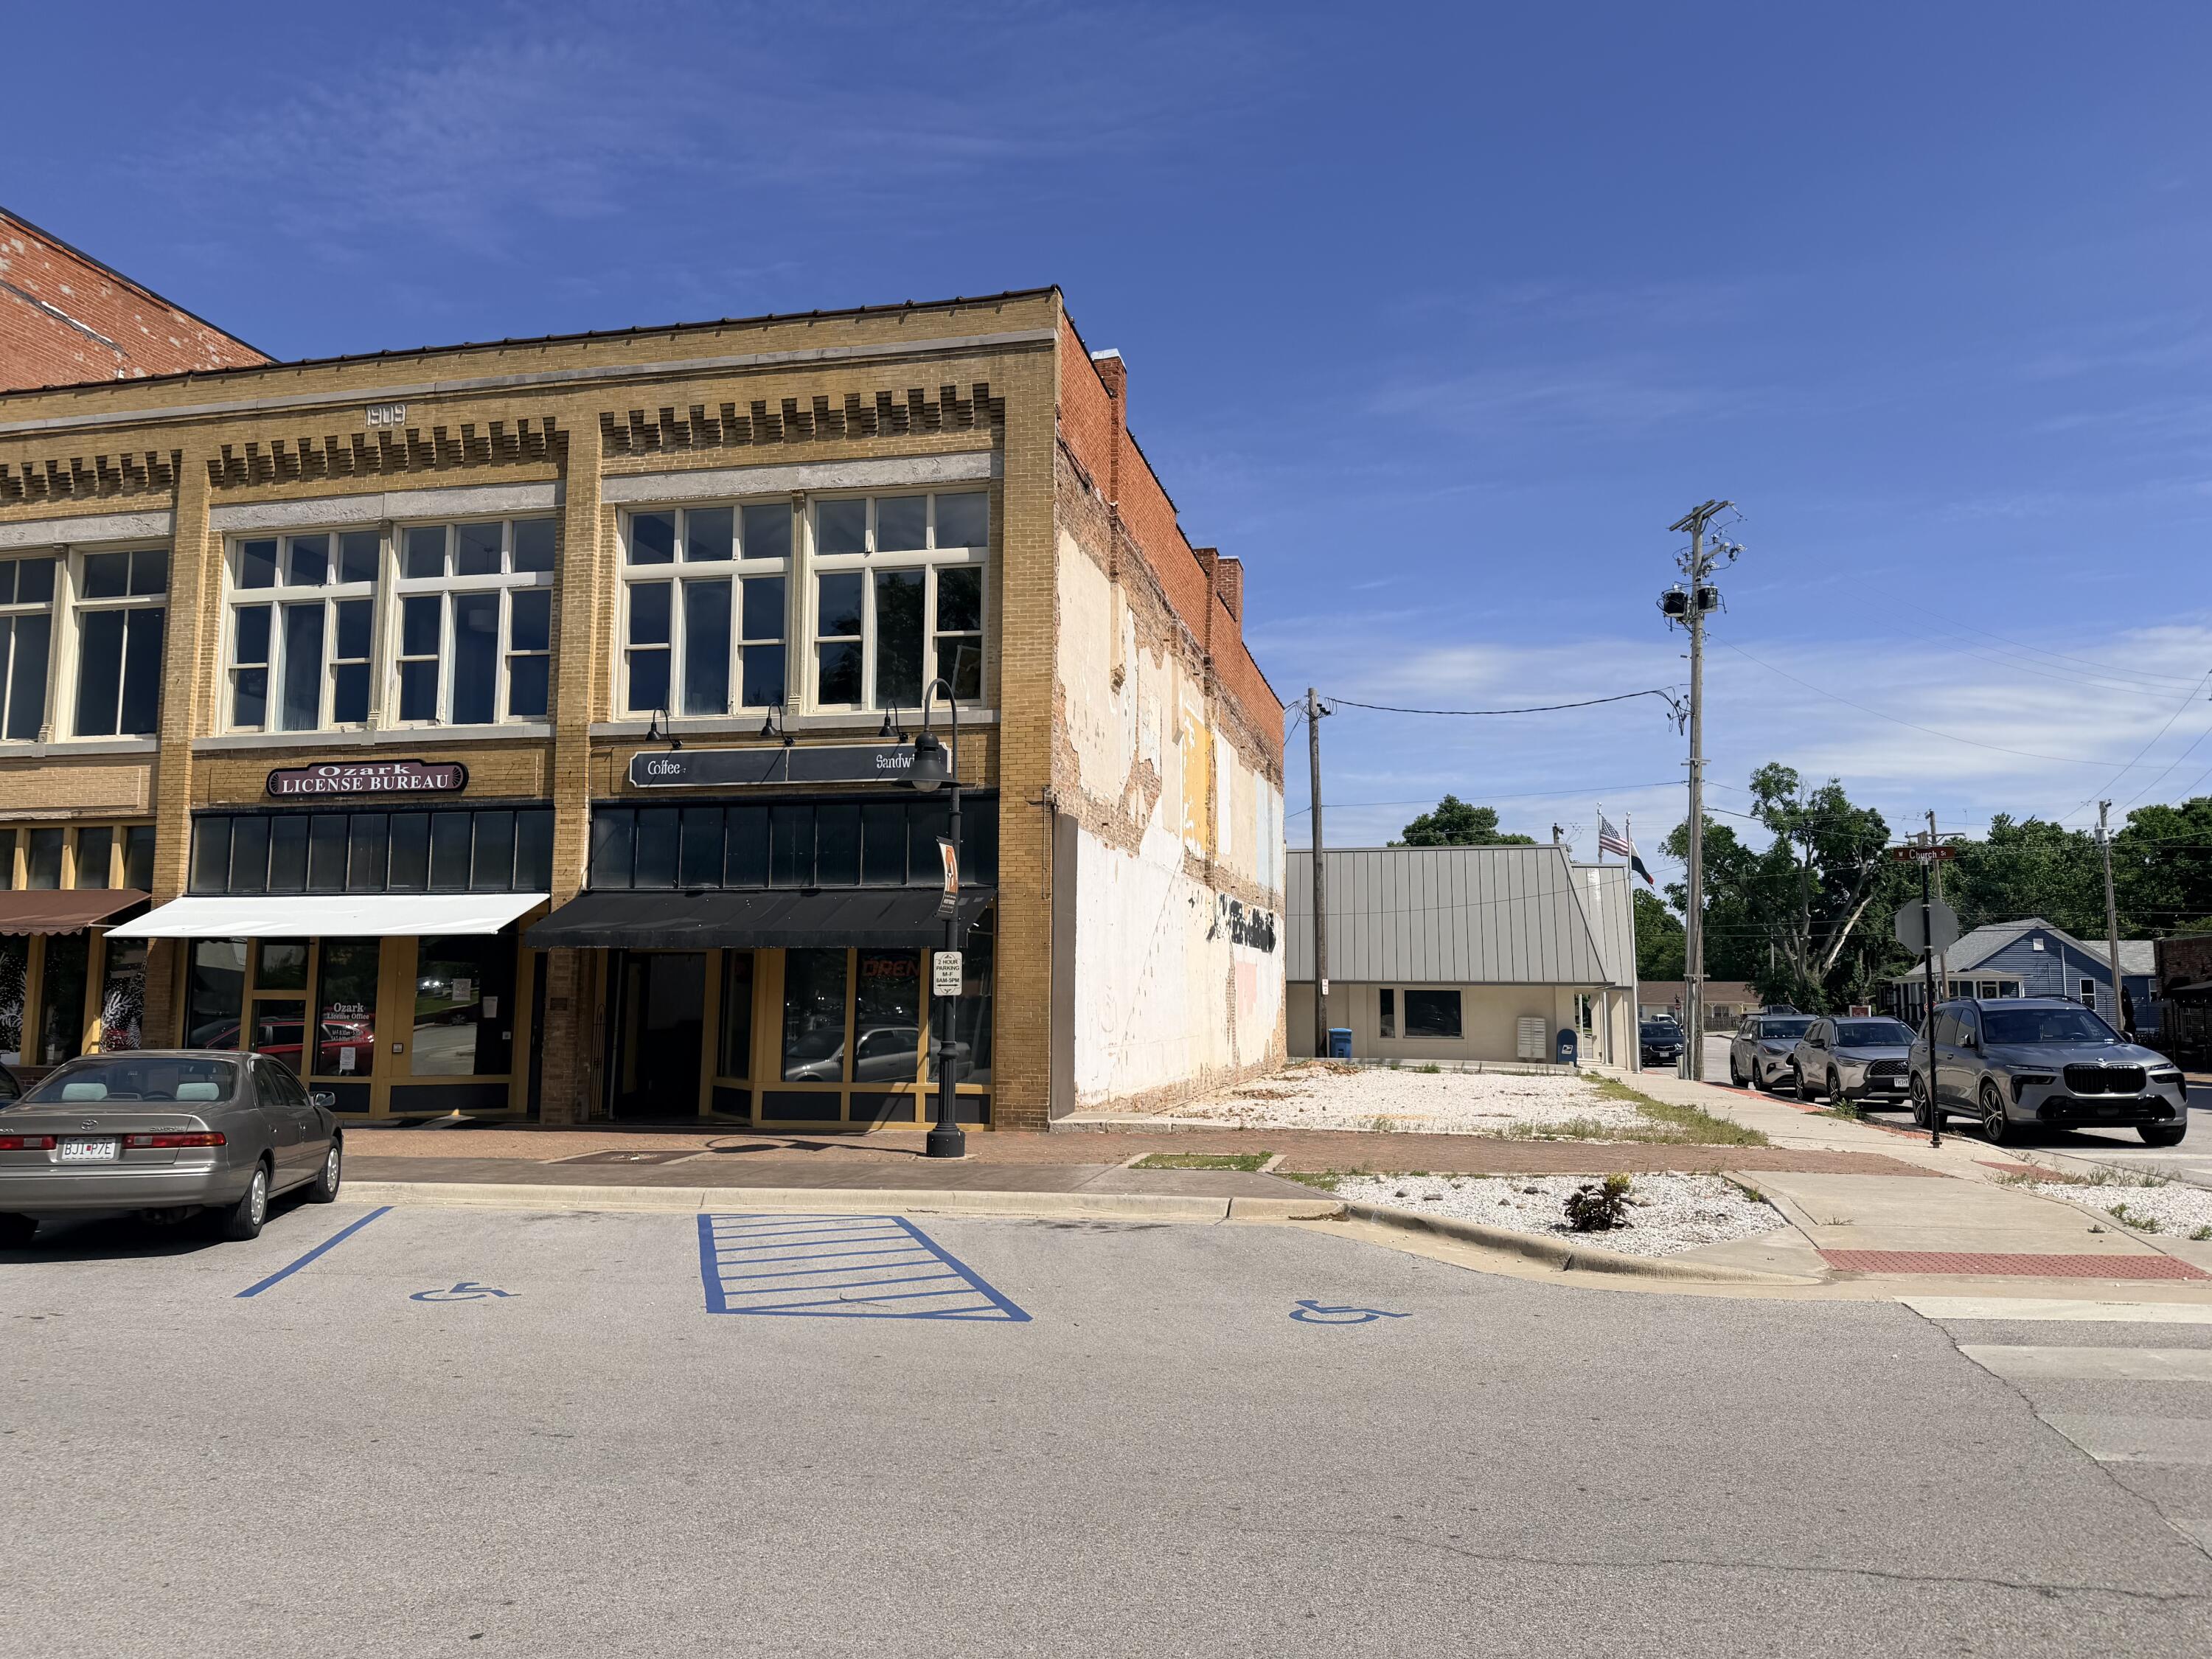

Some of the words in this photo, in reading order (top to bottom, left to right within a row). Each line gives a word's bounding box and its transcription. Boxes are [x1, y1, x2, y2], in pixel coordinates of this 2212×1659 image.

[367, 404, 406, 427] 1909
[319, 764, 411, 777] Ozark
[647, 759, 681, 775] Coffee
[282, 777, 363, 793] LICENSE
[369, 774, 449, 790] BUREAU
[1909, 849, 1937, 860] Church
[333, 1002, 364, 1012] Ozark
[90, 1142, 113, 1155] P7E
